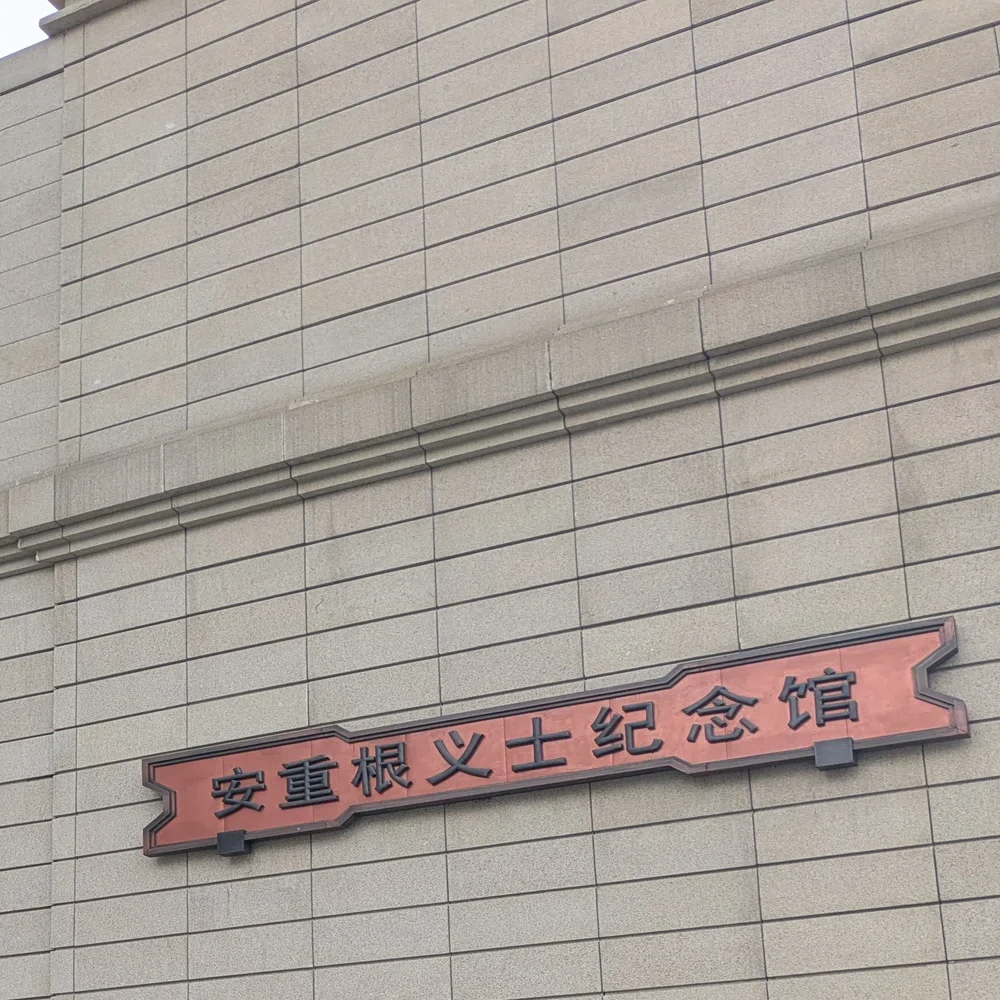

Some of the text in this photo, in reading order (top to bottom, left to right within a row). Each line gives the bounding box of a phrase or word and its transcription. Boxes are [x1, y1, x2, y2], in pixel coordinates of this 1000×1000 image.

[211, 667, 859, 818] 安重根义士纪念馆
